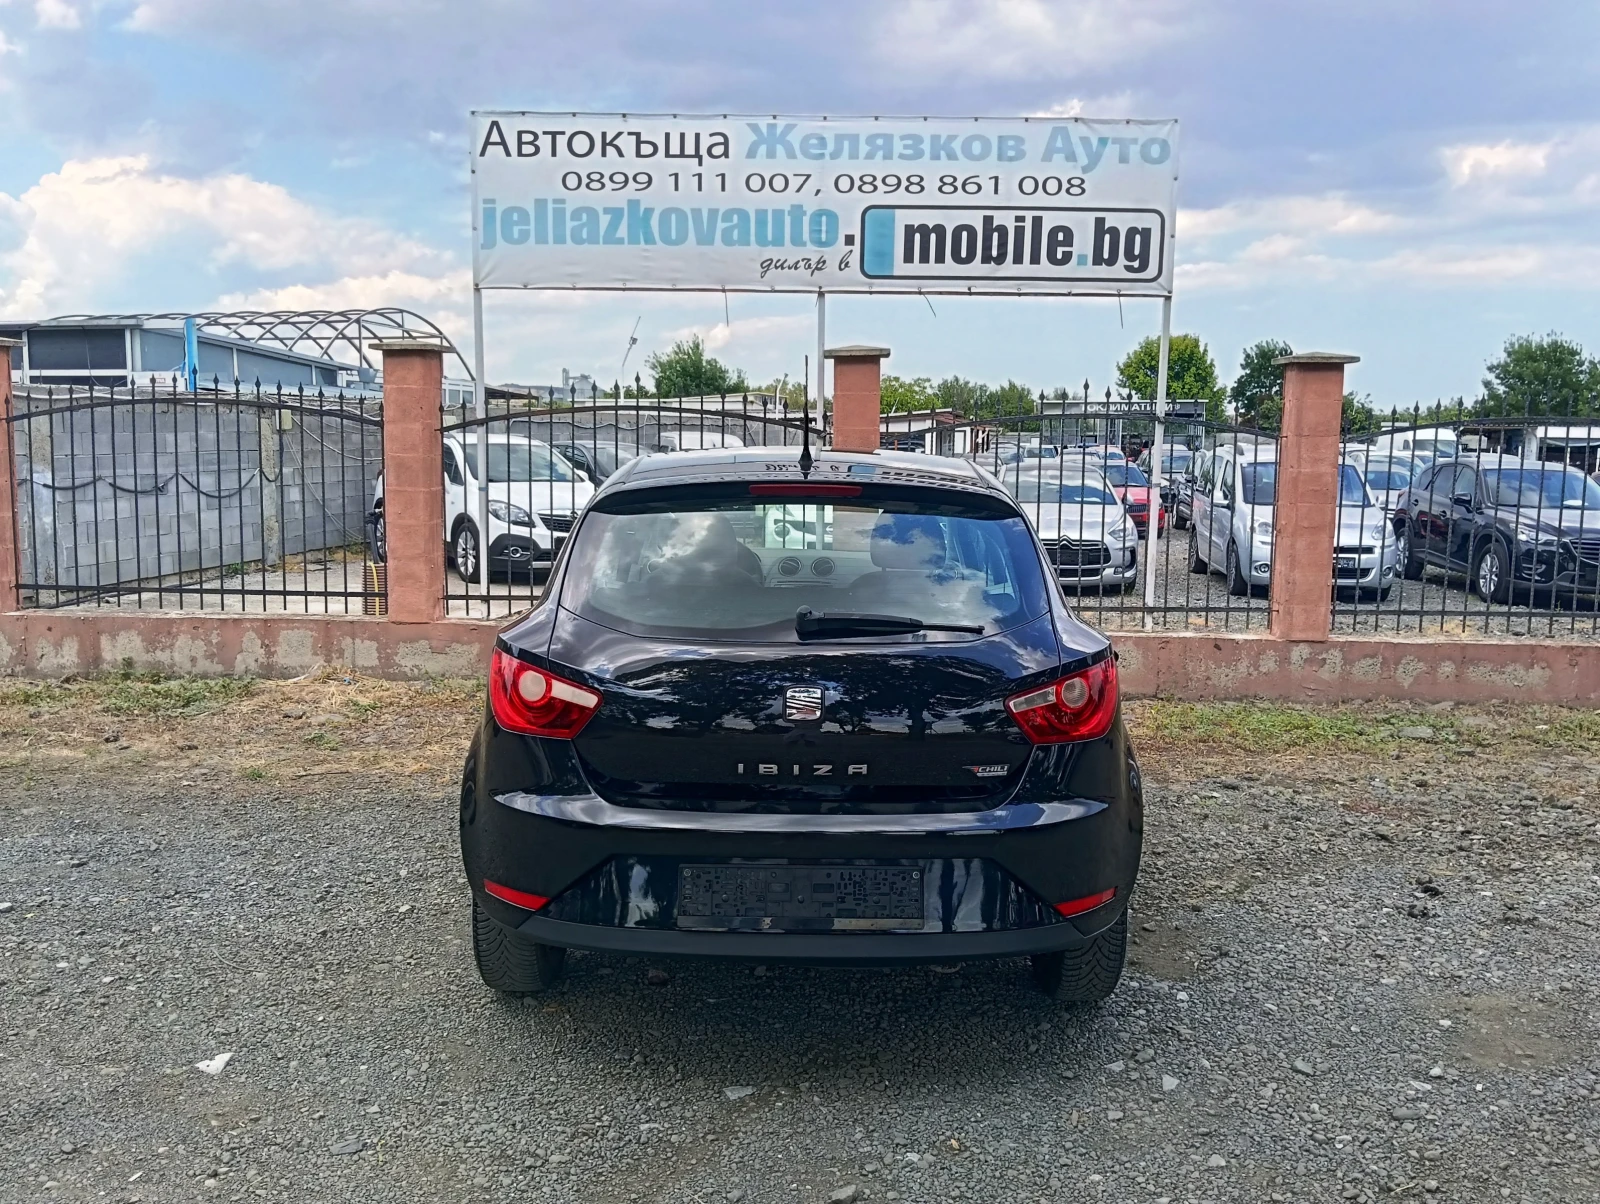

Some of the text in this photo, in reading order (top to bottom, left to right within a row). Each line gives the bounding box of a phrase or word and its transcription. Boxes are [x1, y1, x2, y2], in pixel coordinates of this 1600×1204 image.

[479, 120, 1172, 174] Автокъща Желязков Ауто
[561, 171, 1087, 196] 0899 111 007, 0898 861 008
[760, 255, 827, 279] дилър
[738, 763, 868, 776] IBIZA
[979, 765, 1008, 773] CHILI
